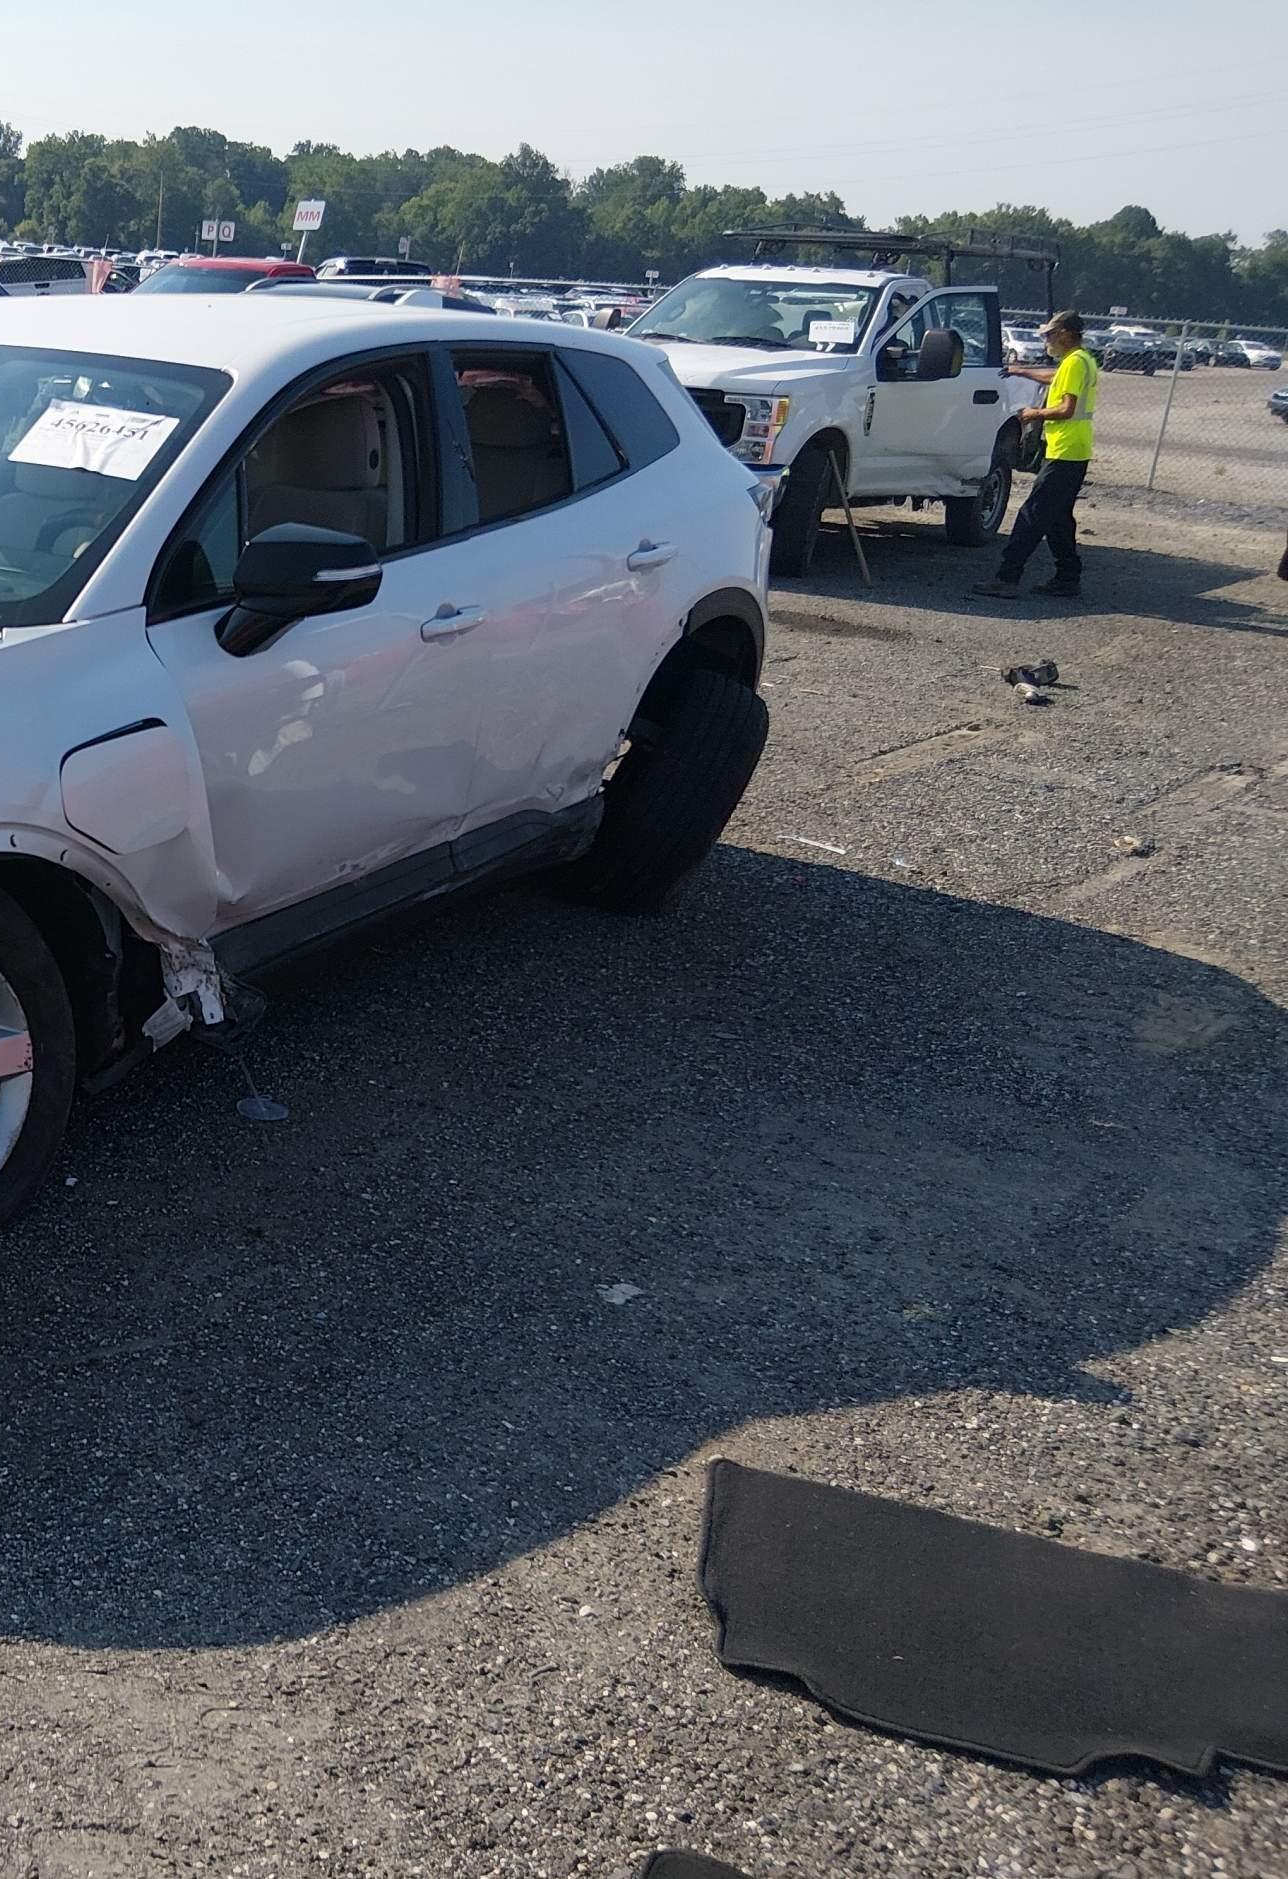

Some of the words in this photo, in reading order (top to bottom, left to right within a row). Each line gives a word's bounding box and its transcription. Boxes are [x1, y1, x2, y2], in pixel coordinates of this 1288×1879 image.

[296, 211, 321, 222] MM
[207, 225, 215, 236] P
[222, 225, 232, 239] Q
